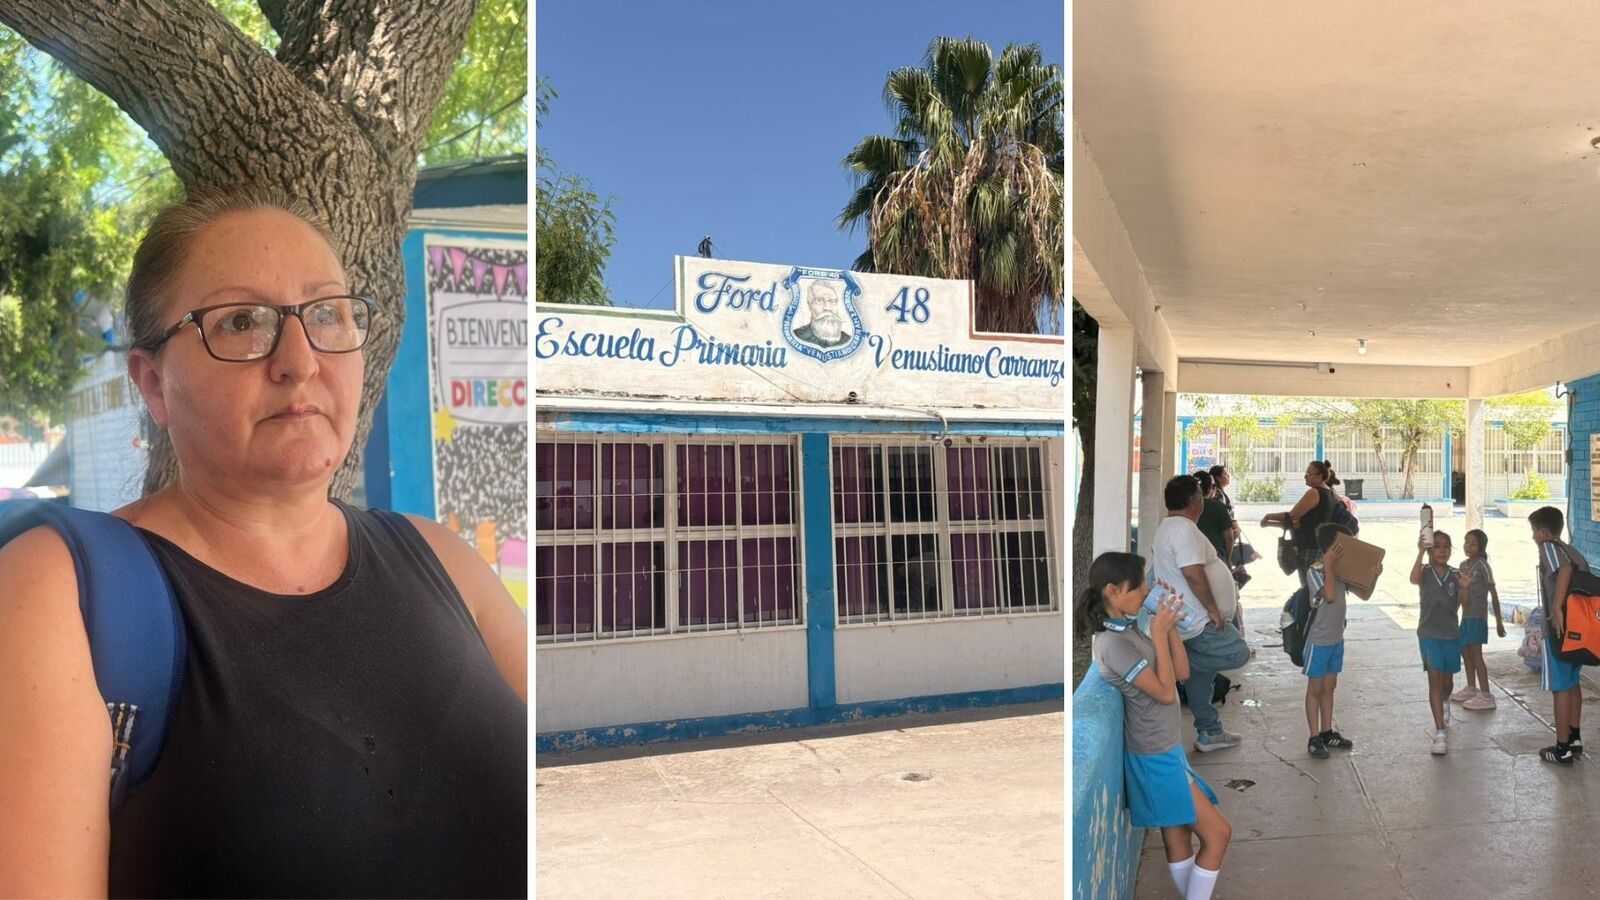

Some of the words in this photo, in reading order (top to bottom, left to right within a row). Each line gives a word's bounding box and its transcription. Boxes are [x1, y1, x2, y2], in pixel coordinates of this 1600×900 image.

[695, 272, 777, 313] Ford
[885, 286, 931, 324] 48
[447, 317, 527, 346] BIENVENI
[536, 317, 655, 360] Escuela
[659, 324, 788, 368] Primaria
[868, 334, 984, 375] Venustiano
[451, 378, 527, 407] DIRECC
